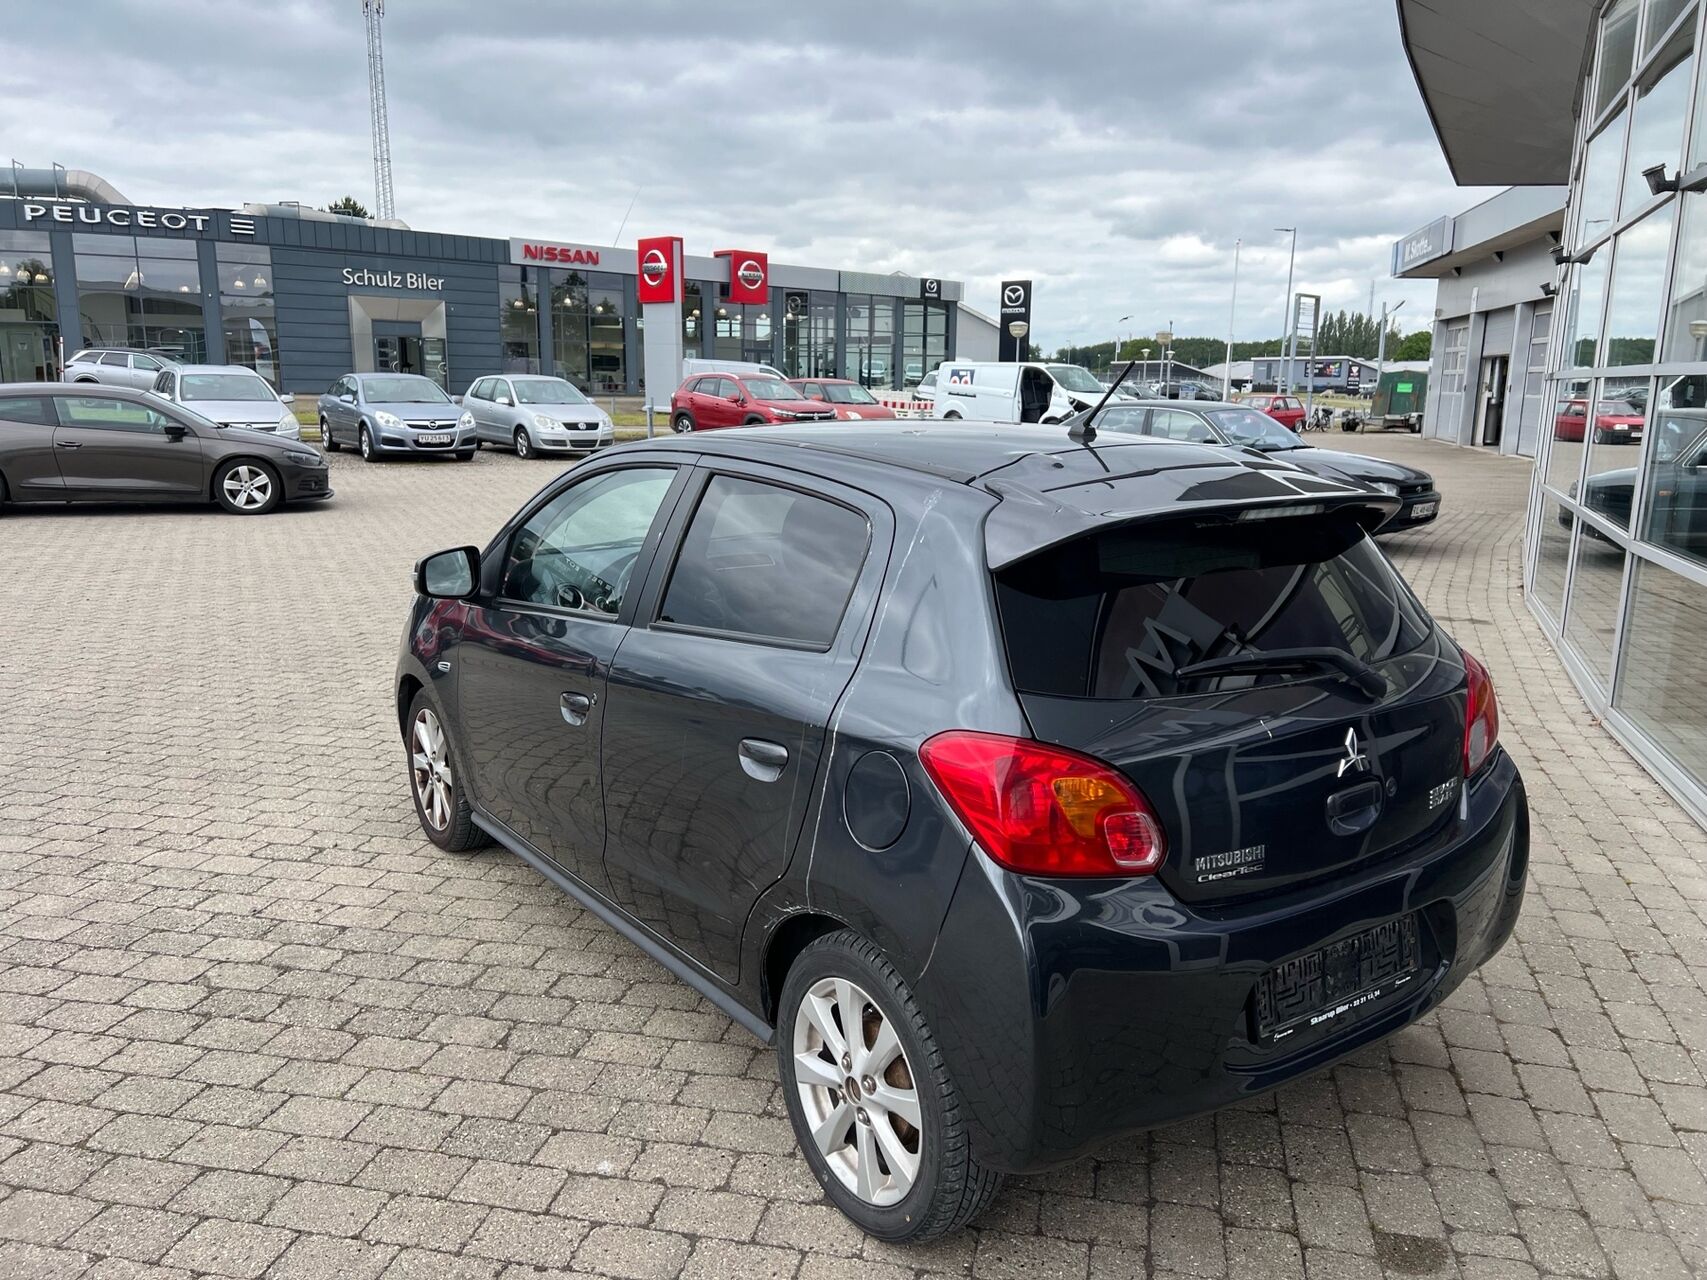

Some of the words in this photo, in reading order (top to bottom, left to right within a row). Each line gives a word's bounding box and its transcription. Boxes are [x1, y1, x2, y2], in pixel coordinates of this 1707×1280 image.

[24, 204, 210, 231] PEUGEOT
[523, 244, 600, 266] NISSAN
[342, 267, 402, 288] Schulz
[406, 272, 445, 290] Biler
[1196, 844, 1265, 871] MITSUBISHI
[1197, 864, 1263, 883] ClearTec
